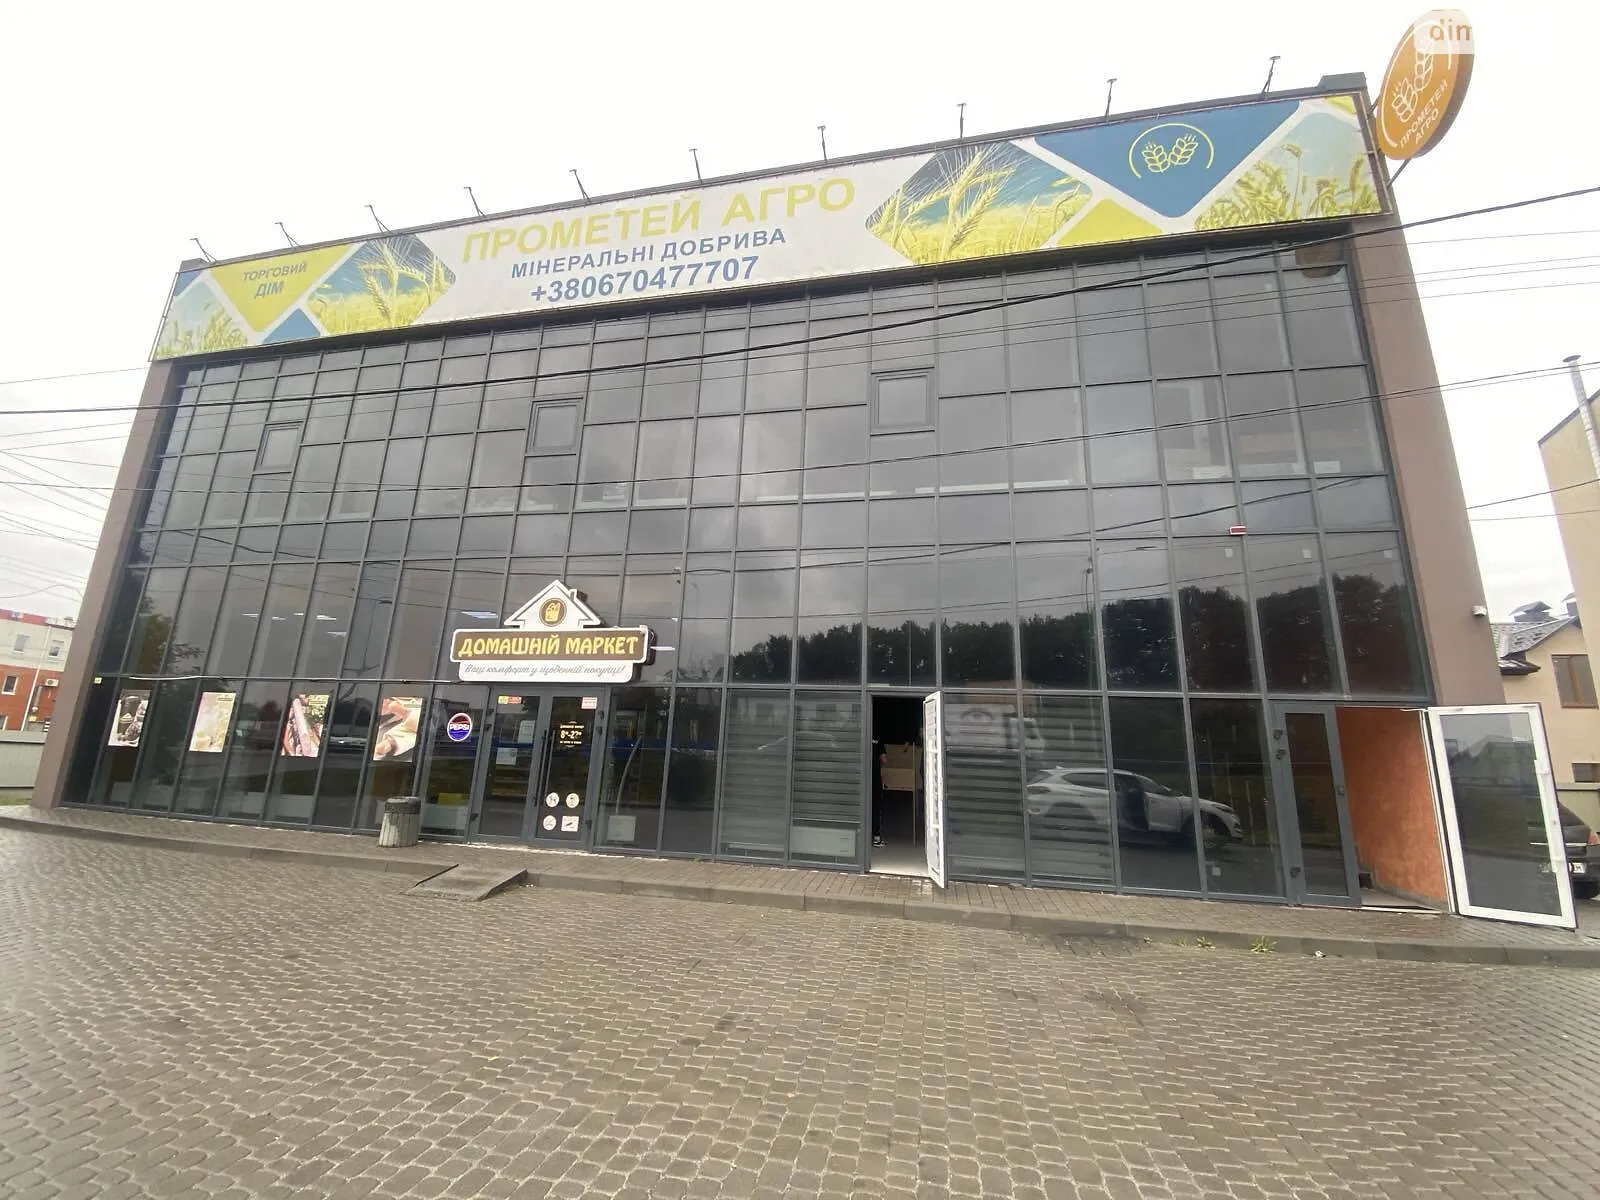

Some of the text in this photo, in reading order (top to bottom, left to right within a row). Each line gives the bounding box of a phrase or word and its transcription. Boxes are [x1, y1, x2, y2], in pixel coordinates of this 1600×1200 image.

[1415, 108, 1439, 143] АГРО
[462, 177, 856, 263] ПРОМЕТЕЙ АГРО
[511, 227, 786, 279] МІНЕРАЛЬНІ ДОБРИВА
[243, 260, 308, 282] ТОРГОВИЙ
[531, 255, 760, 303] +380670477707
[254, 279, 285, 299] ДІМ
[458, 633, 639, 658] ДОМАШНІЙ МАРКЕТ
[486, 664, 530, 676] комфорт
